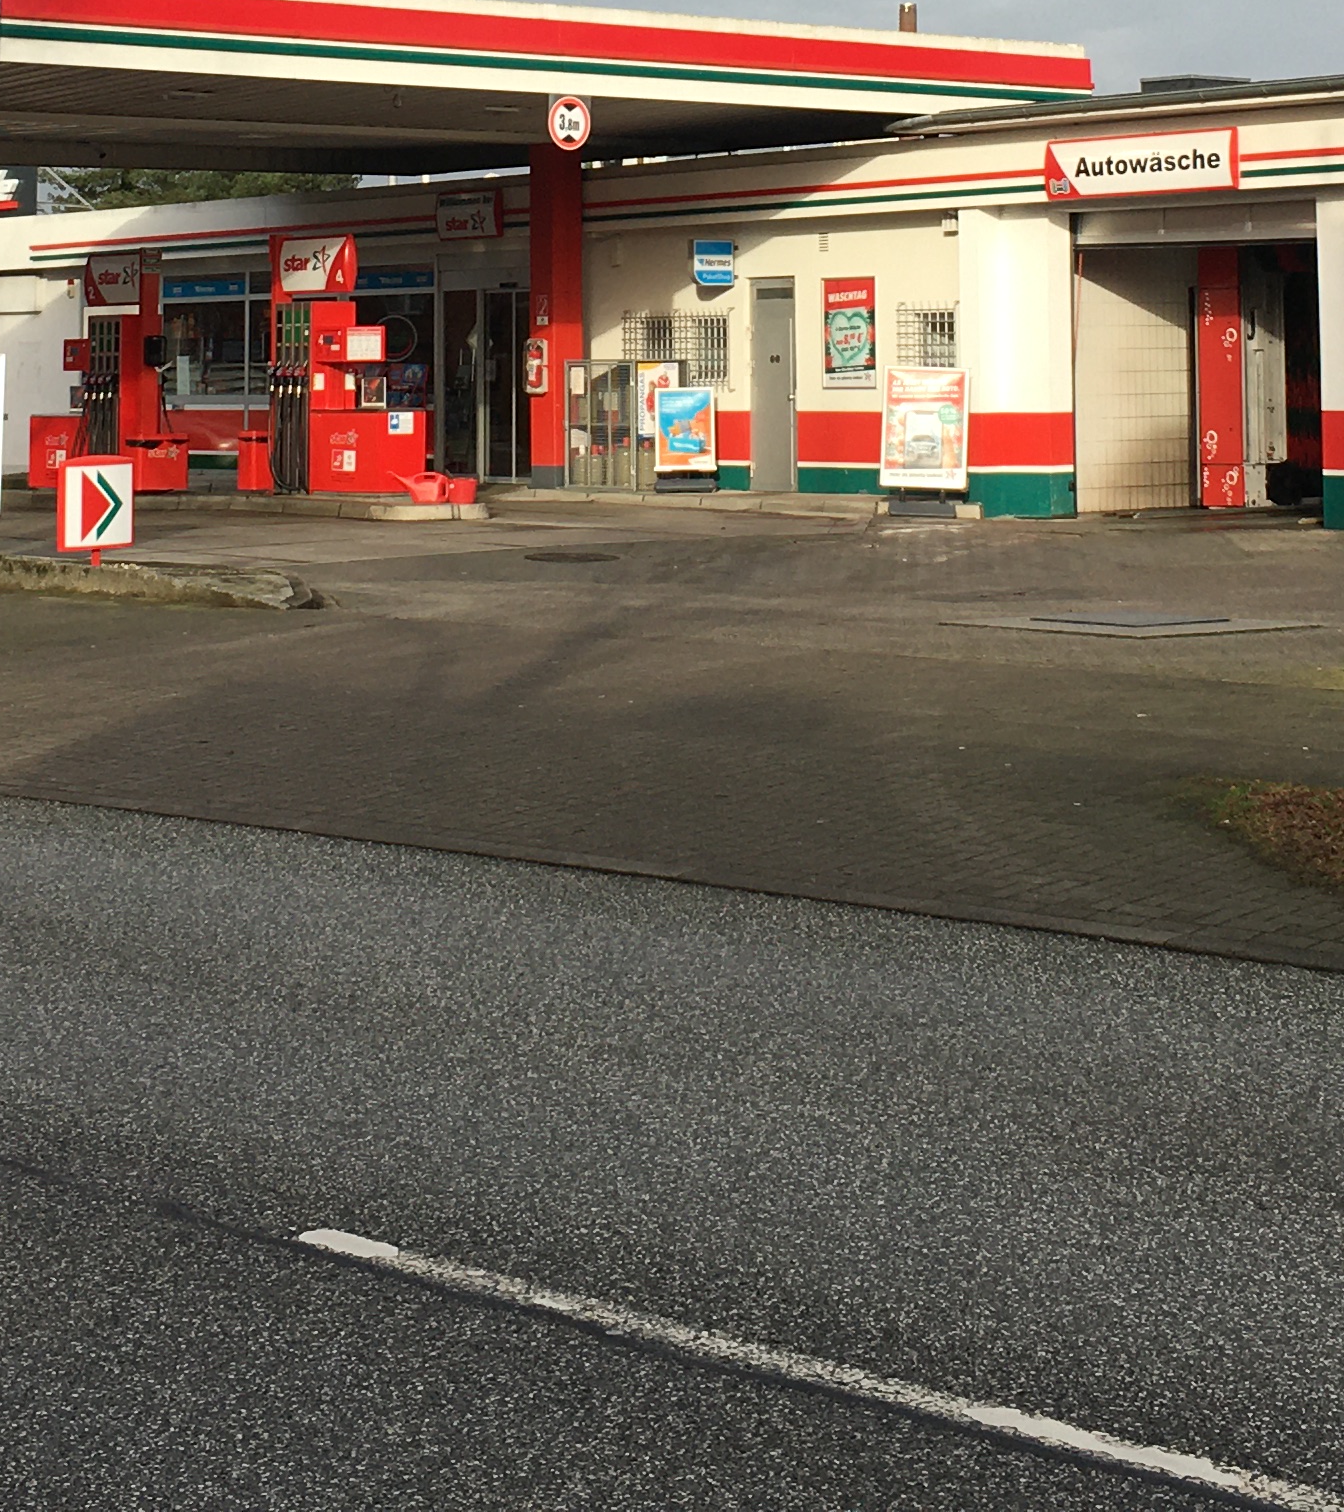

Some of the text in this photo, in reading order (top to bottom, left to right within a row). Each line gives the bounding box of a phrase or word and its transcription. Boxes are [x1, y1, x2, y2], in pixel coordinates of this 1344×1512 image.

[1074, 149, 1222, 178] Autowäsche
[445, 216, 470, 231] star
[283, 254, 311, 272] star
[705, 258, 732, 267] Hermes
[97, 268, 122, 285] star
[335, 269, 344, 284] 4
[88, 286, 96, 300] 2
[827, 289, 868, 303] WASCHTAG
